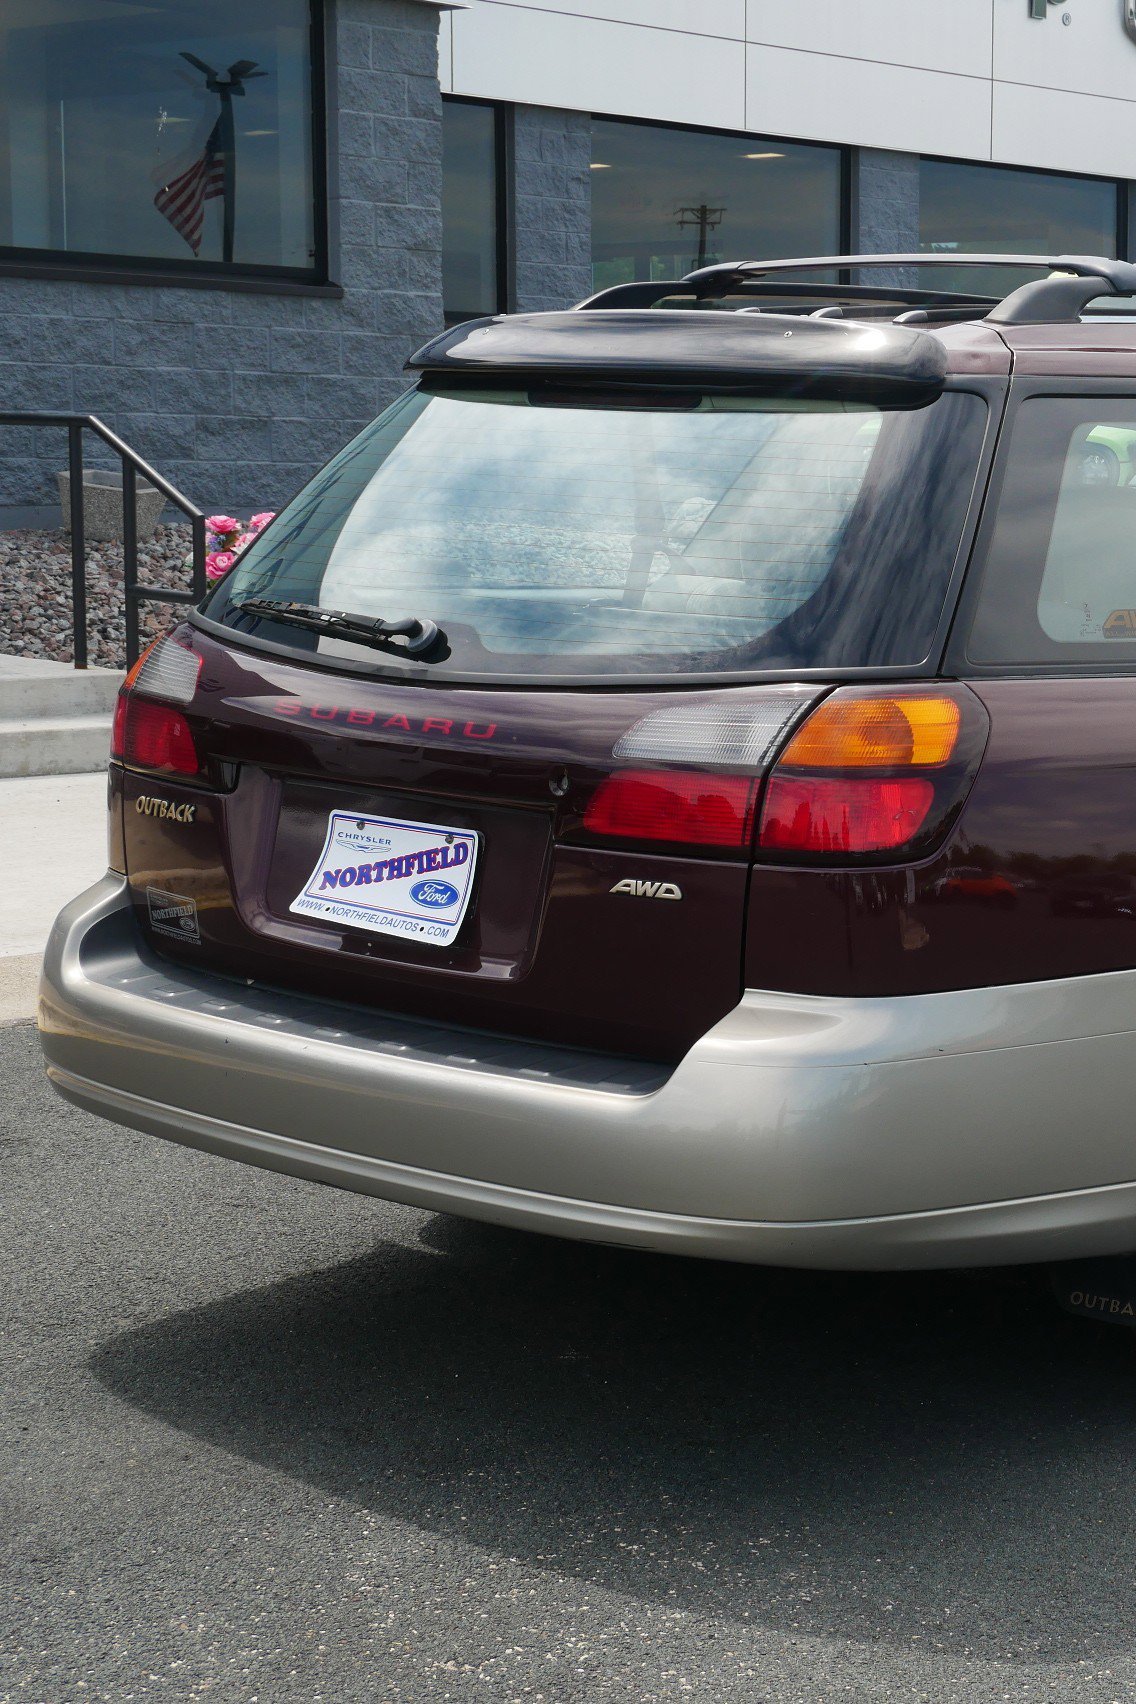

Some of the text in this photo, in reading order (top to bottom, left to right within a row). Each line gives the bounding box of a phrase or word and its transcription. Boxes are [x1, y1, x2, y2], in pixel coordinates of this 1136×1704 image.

[272, 698, 497, 740] SUBARU
[135, 795, 196, 823] OUTBACK
[337, 831, 392, 846] CHRYSLER
[318, 841, 469, 891] NORTHFIELD
[417, 882, 451, 905] Ford
[608, 879, 682, 900] AWD
[151, 904, 194, 920] NORTHFIELD
